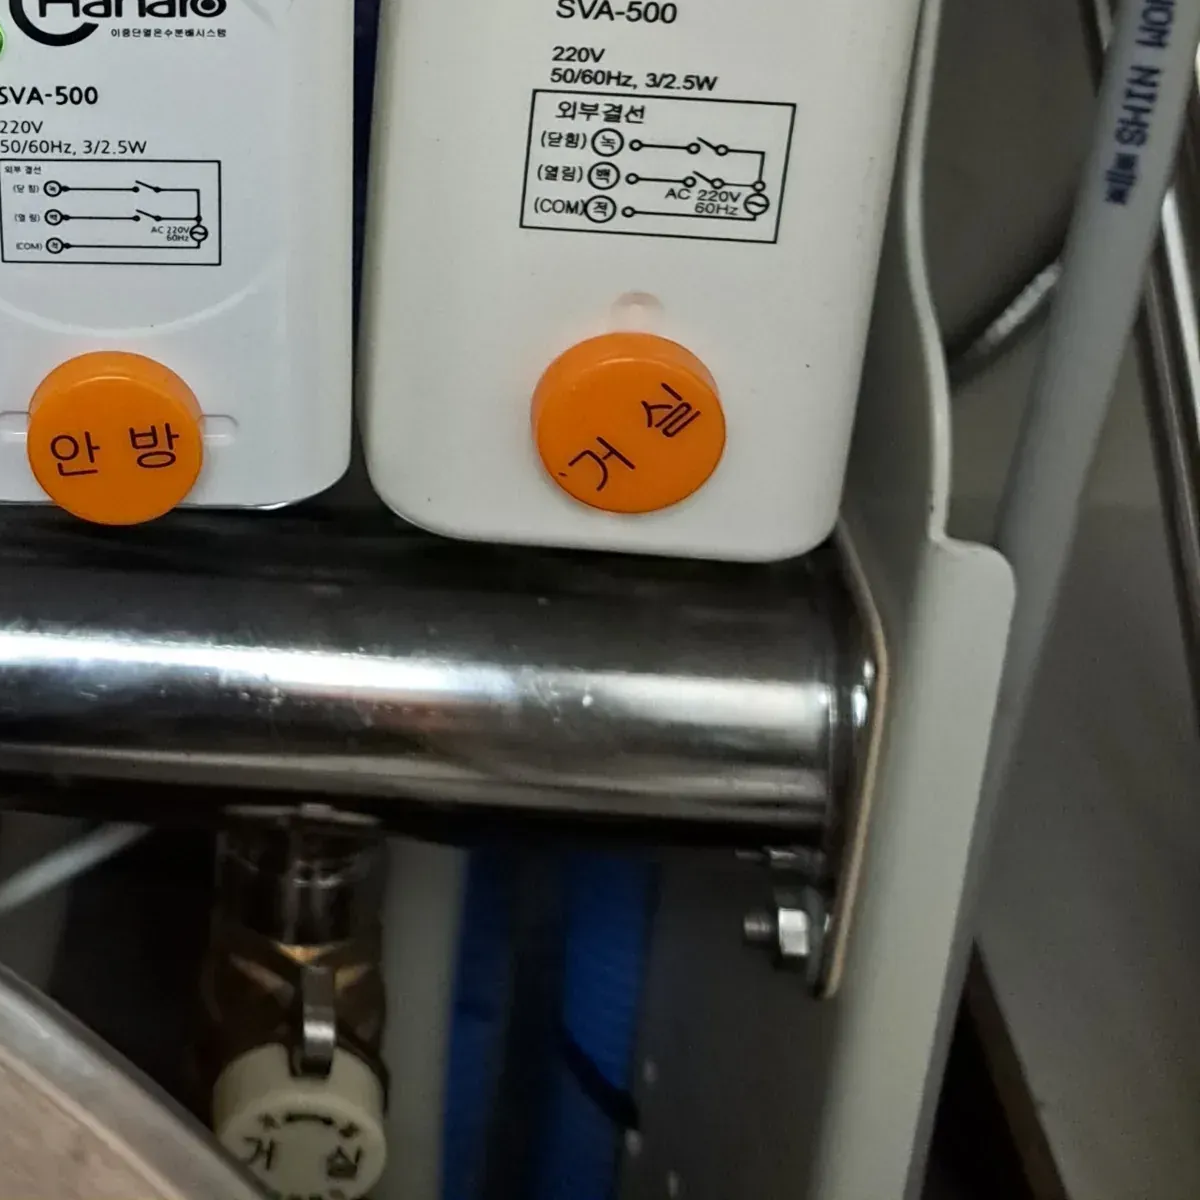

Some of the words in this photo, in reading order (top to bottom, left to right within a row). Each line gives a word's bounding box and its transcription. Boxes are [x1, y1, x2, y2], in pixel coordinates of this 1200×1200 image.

[551, 46, 605, 63] 220V
[550, 68, 637, 90] 50/60Hz,
[645, 72, 718, 91] 3/2.5W
[555, 101, 646, 124] 외부결선
[1114, 64, 1161, 147] SHIN
[0, 139, 76, 155] 50/60Hz,
[83, 140, 147, 154] 3/2.5W
[664, 187, 691, 201] AC
[697, 189, 741, 203] 220V
[534, 198, 585, 215] (COM)
[694, 202, 739, 216] 60Hz
[150, 226, 164, 234] AC
[166, 226, 190, 234] 220V
[166, 234, 190, 242] 60Hz
[16, 242, 43, 251] (COM)
[50, 422, 180, 477] 안방
